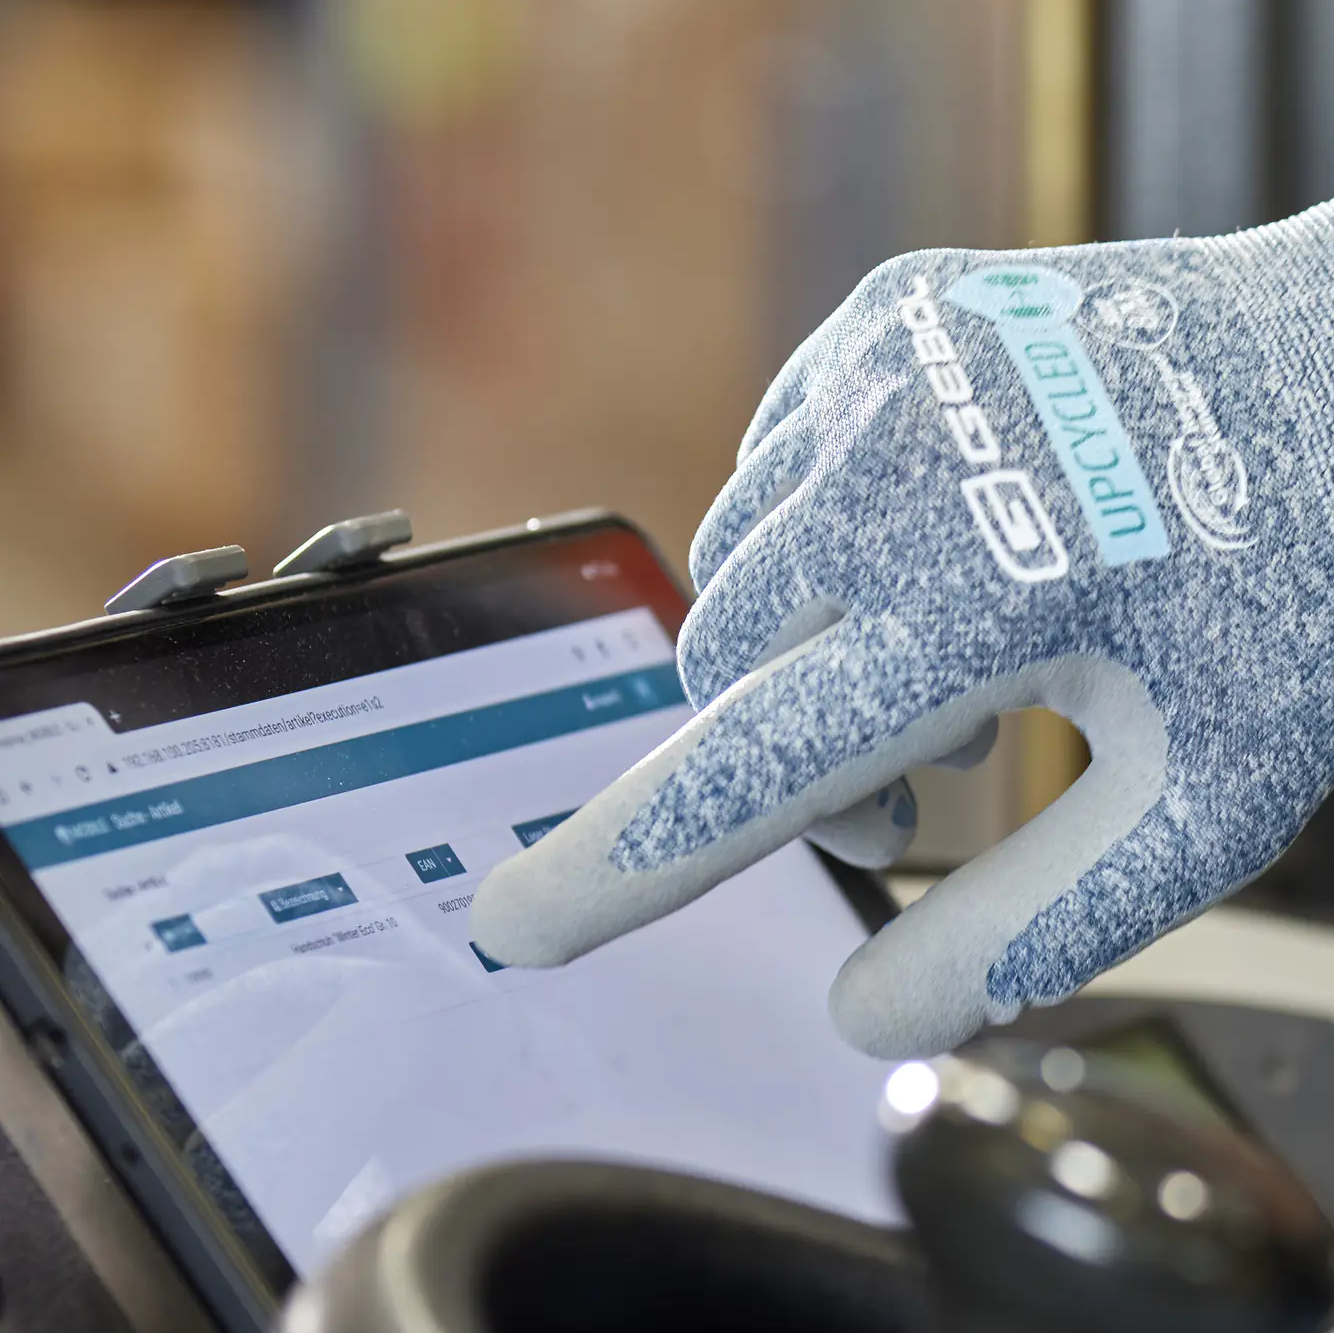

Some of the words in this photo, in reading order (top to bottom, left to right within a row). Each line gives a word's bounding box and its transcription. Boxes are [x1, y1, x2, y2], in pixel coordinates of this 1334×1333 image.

[899, 274, 1001, 464] GEBOL
[1024, 340, 1146, 538] UPCYCLED
[417, 858, 437, 871] EAN
[385, 916, 399, 928] 10
